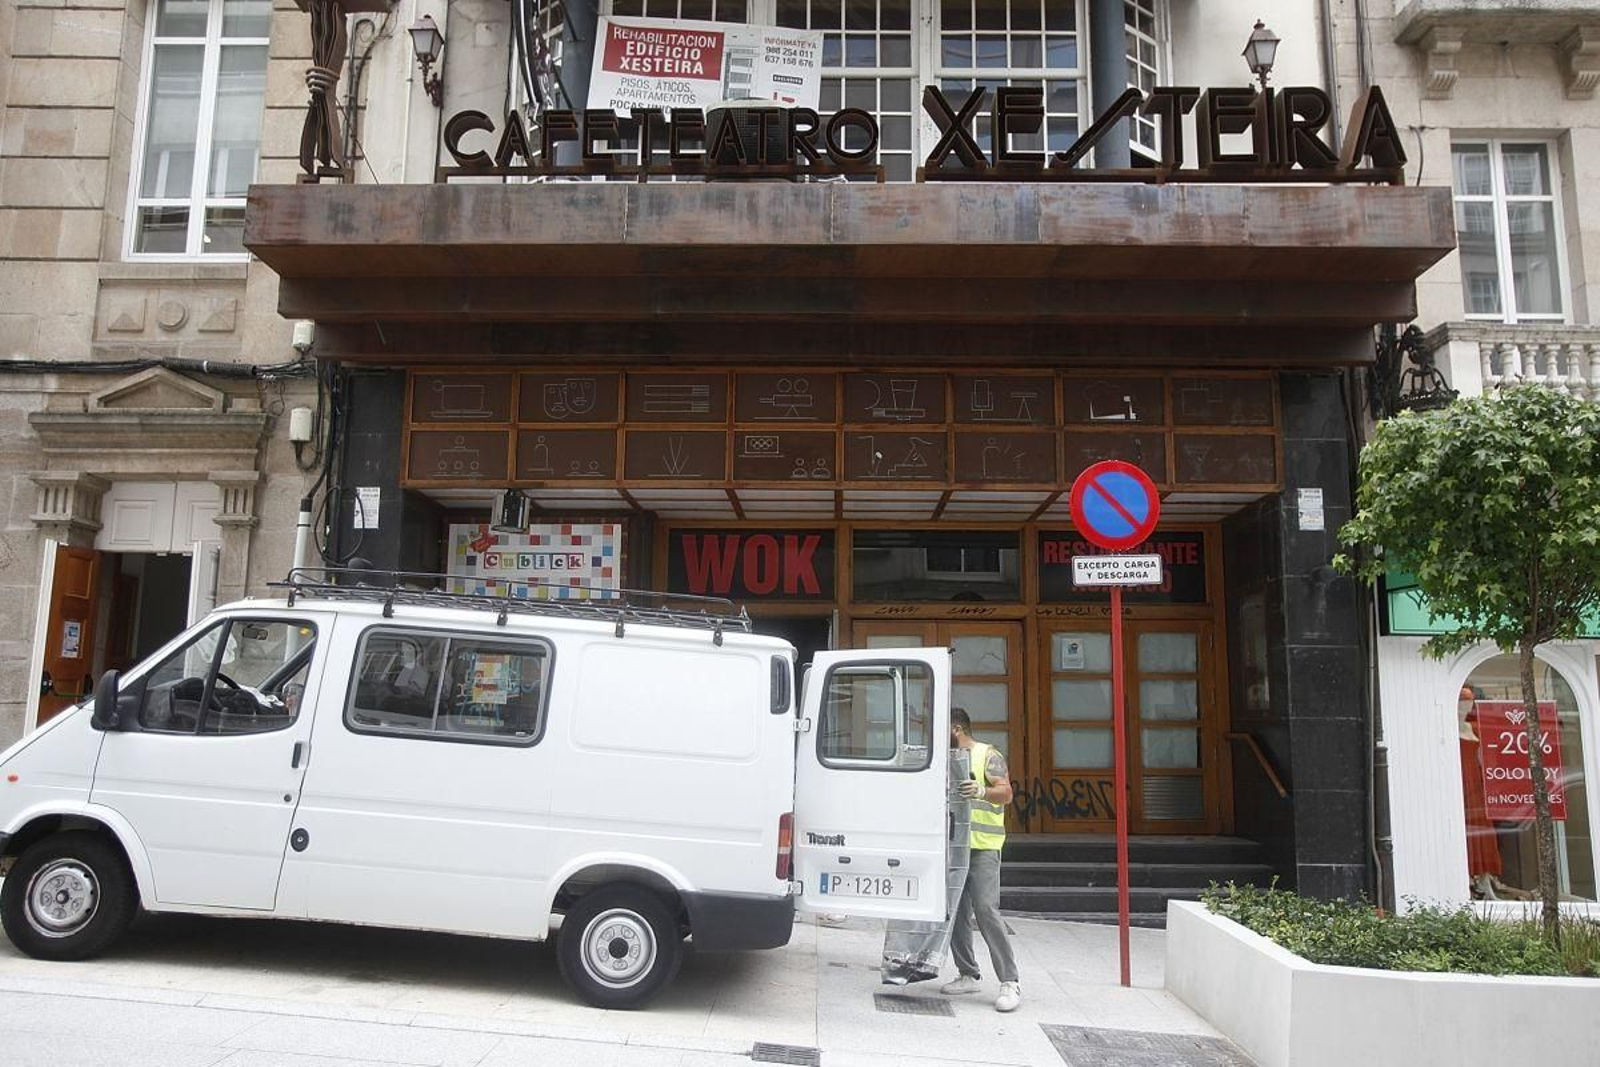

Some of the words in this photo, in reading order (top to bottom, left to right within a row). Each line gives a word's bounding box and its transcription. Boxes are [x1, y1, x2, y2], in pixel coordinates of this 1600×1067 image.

[625, 40, 701, 61] EDIFICIO
[619, 56, 704, 75] XESTEIRA
[765, 55, 780, 64] 637
[620, 76, 652, 90] PISOS,
[615, 87, 697, 104] APARTAMENTOS
[443, 107, 880, 167] CAFETEATRO
[485, 554, 584, 569] Cubick
[681, 533, 823, 595] WOK
[1077, 562, 1120, 570] EXCEPTO
[1124, 560, 1157, 569] CARGA
[1098, 571, 1149, 580] DESCARGA
[1486, 767, 1525, 780] SOLO
[1488, 795, 1498, 803] EN
[806, 832, 846, 847] Transit
[831, 875, 842, 893] P
[855, 876, 892, 895] 1218
